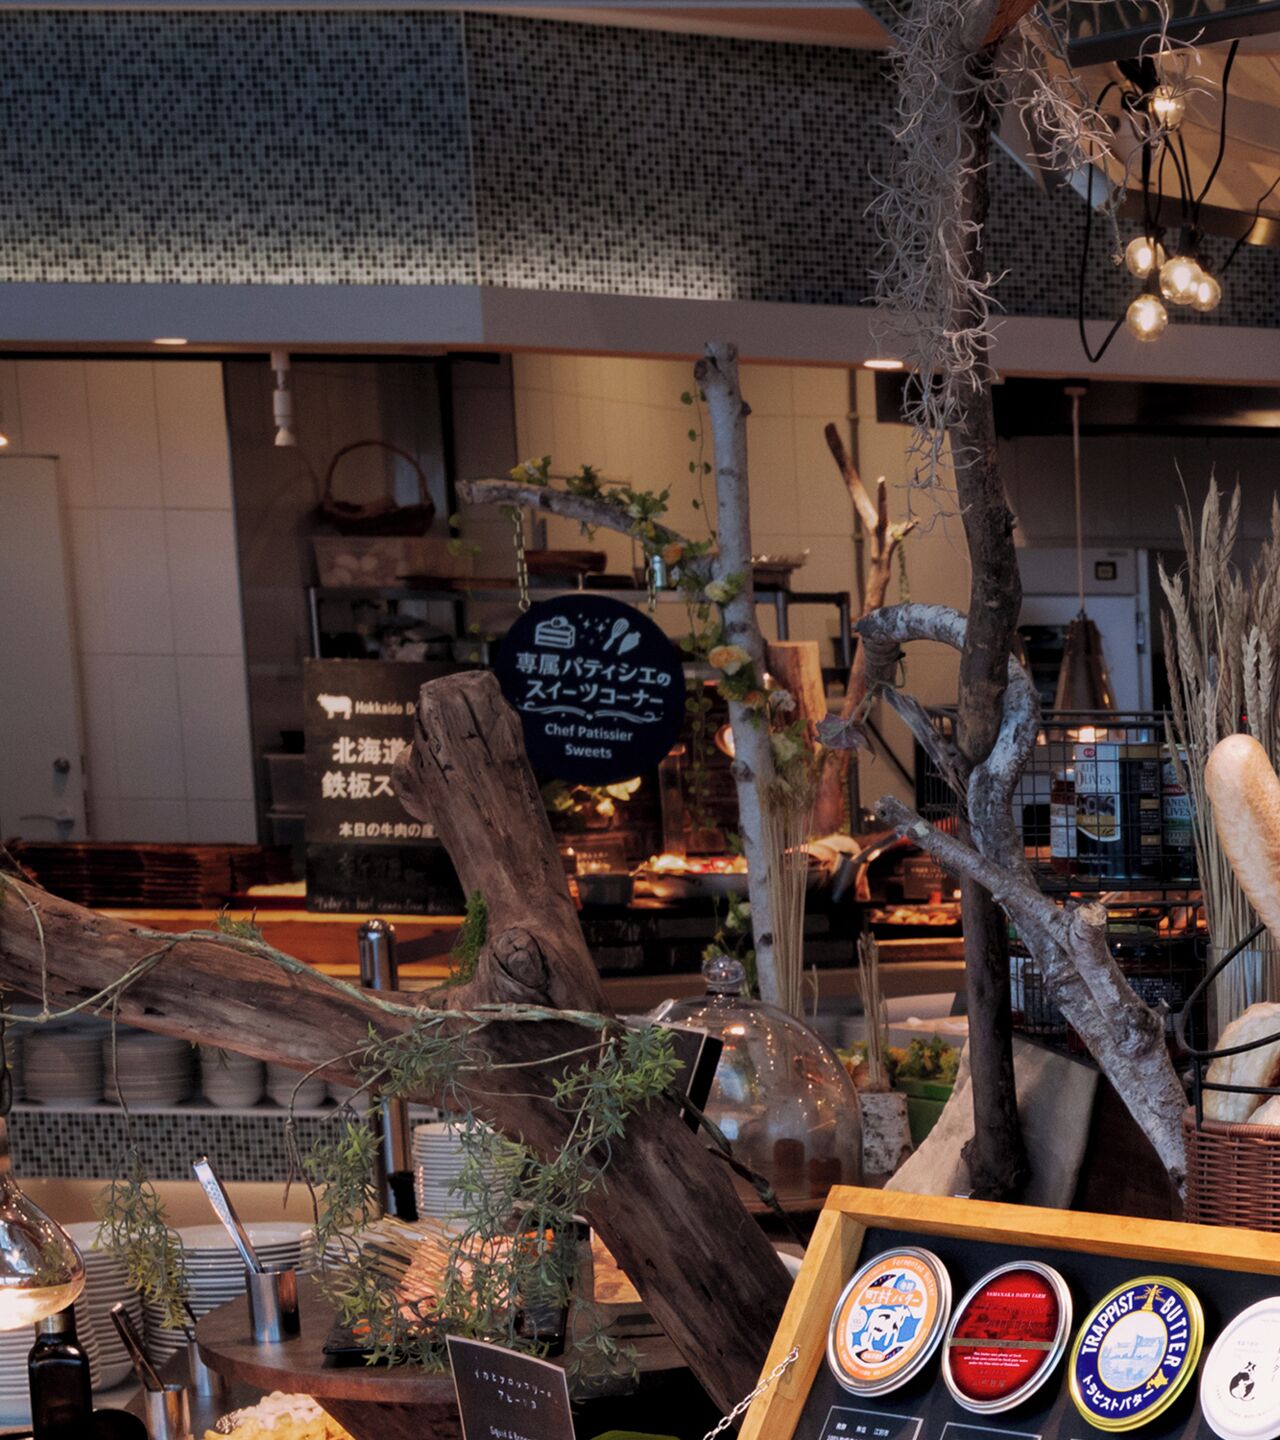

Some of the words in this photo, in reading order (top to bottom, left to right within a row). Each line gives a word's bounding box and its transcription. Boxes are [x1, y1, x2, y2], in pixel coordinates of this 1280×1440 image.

[515, 652, 672, 687] 専属パティシエの
[354, 700, 404, 716] Hokkaido
[526, 679, 664, 708] スイーツコーナー
[544, 723, 575, 736] Chef
[578, 726, 634, 742] Patissier
[332, 736, 410, 766] 北海道
[564, 743, 613, 759] Sweets
[321, 770, 396, 799] 鉄板ス
[339, 821, 439, 839] 本日の牛肉の産
[864, 1290, 920, 1305] 町村バター
[1081, 1290, 1135, 1355] TRAPPIST
[1159, 1295, 1187, 1368] BUTTER
[1083, 1374, 1155, 1411] トラピストバター
